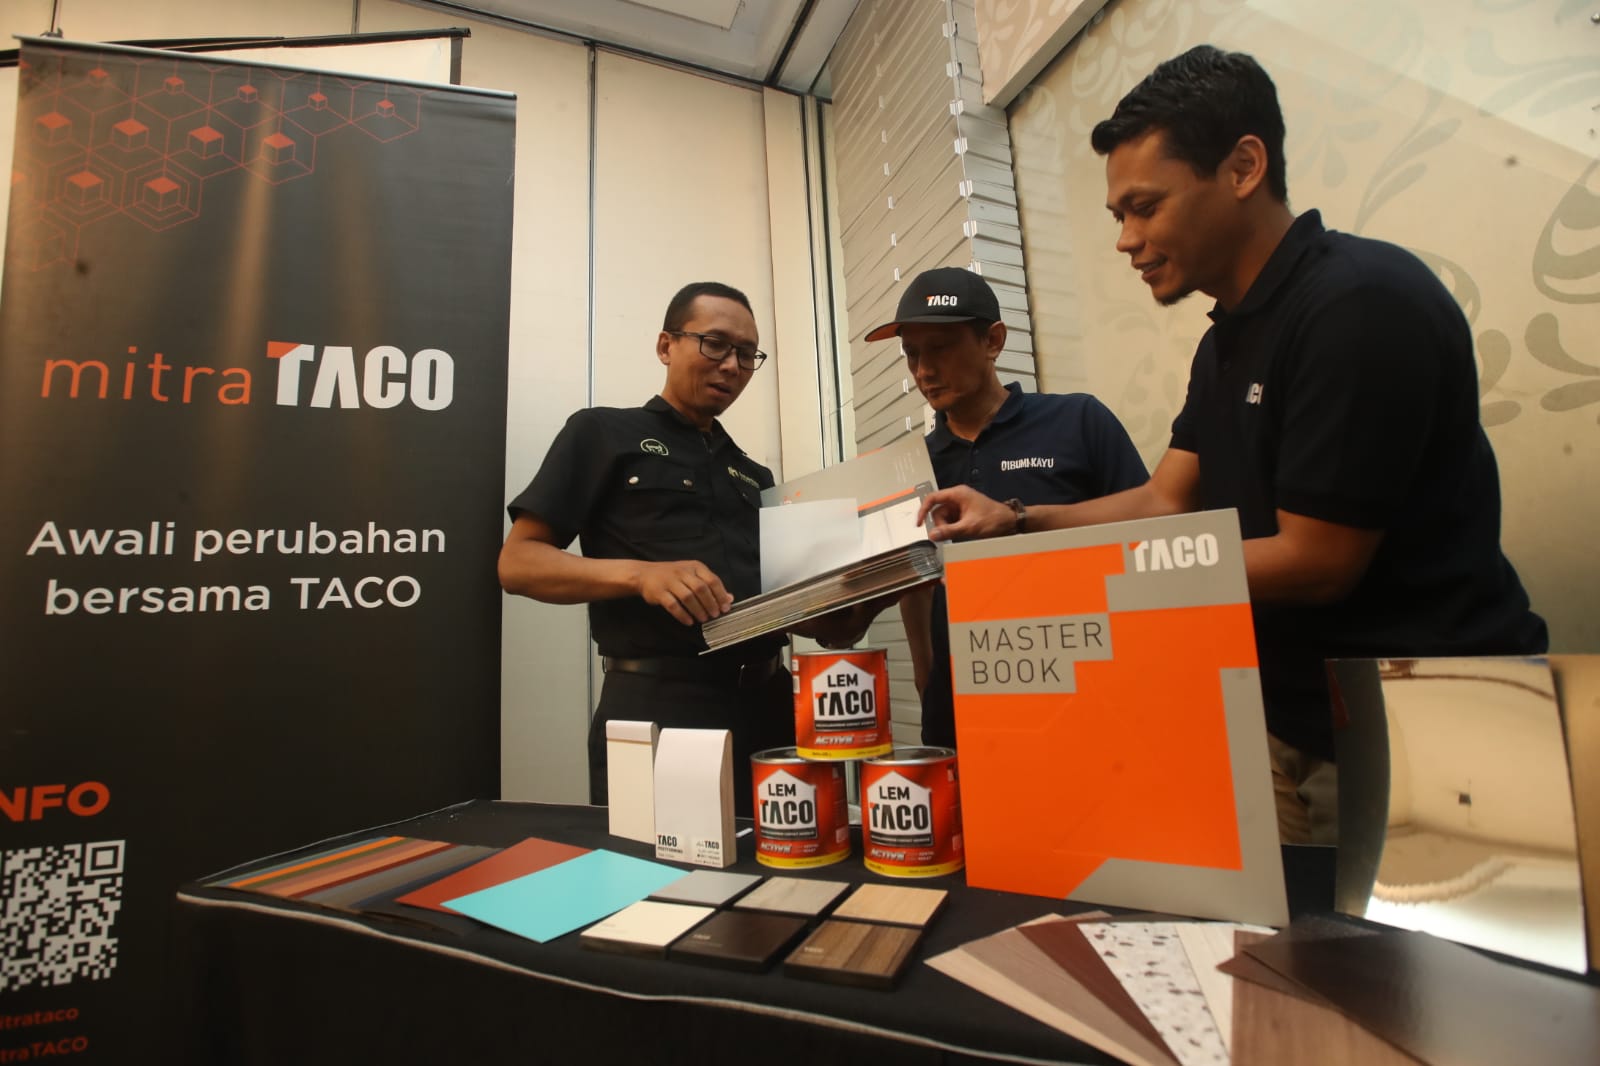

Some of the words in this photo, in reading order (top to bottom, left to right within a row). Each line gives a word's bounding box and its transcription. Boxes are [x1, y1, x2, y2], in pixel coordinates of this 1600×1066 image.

[927, 295, 958, 307] TACO
[41, 346, 253, 405] mitra
[266, 341, 455, 411] TACO
[26, 521, 176, 556] Awali
[194, 521, 446, 562] perubahan
[1128, 533, 1219, 572] TACO
[45, 579, 271, 615] bersama
[290, 575, 422, 610] TACO
[969, 621, 1103, 653] MASTER
[827, 673, 859, 688] LEM
[972, 658, 1060, 685] BOOK
[815, 689, 874, 717] TACO
[768, 783, 796, 796] LEM
[879, 785, 909, 800] LEM
[760, 799, 814, 825] TACO
[869, 802, 929, 830] TACO
[657, 834, 677, 847] TACO
[705, 840, 719, 849] TACO
